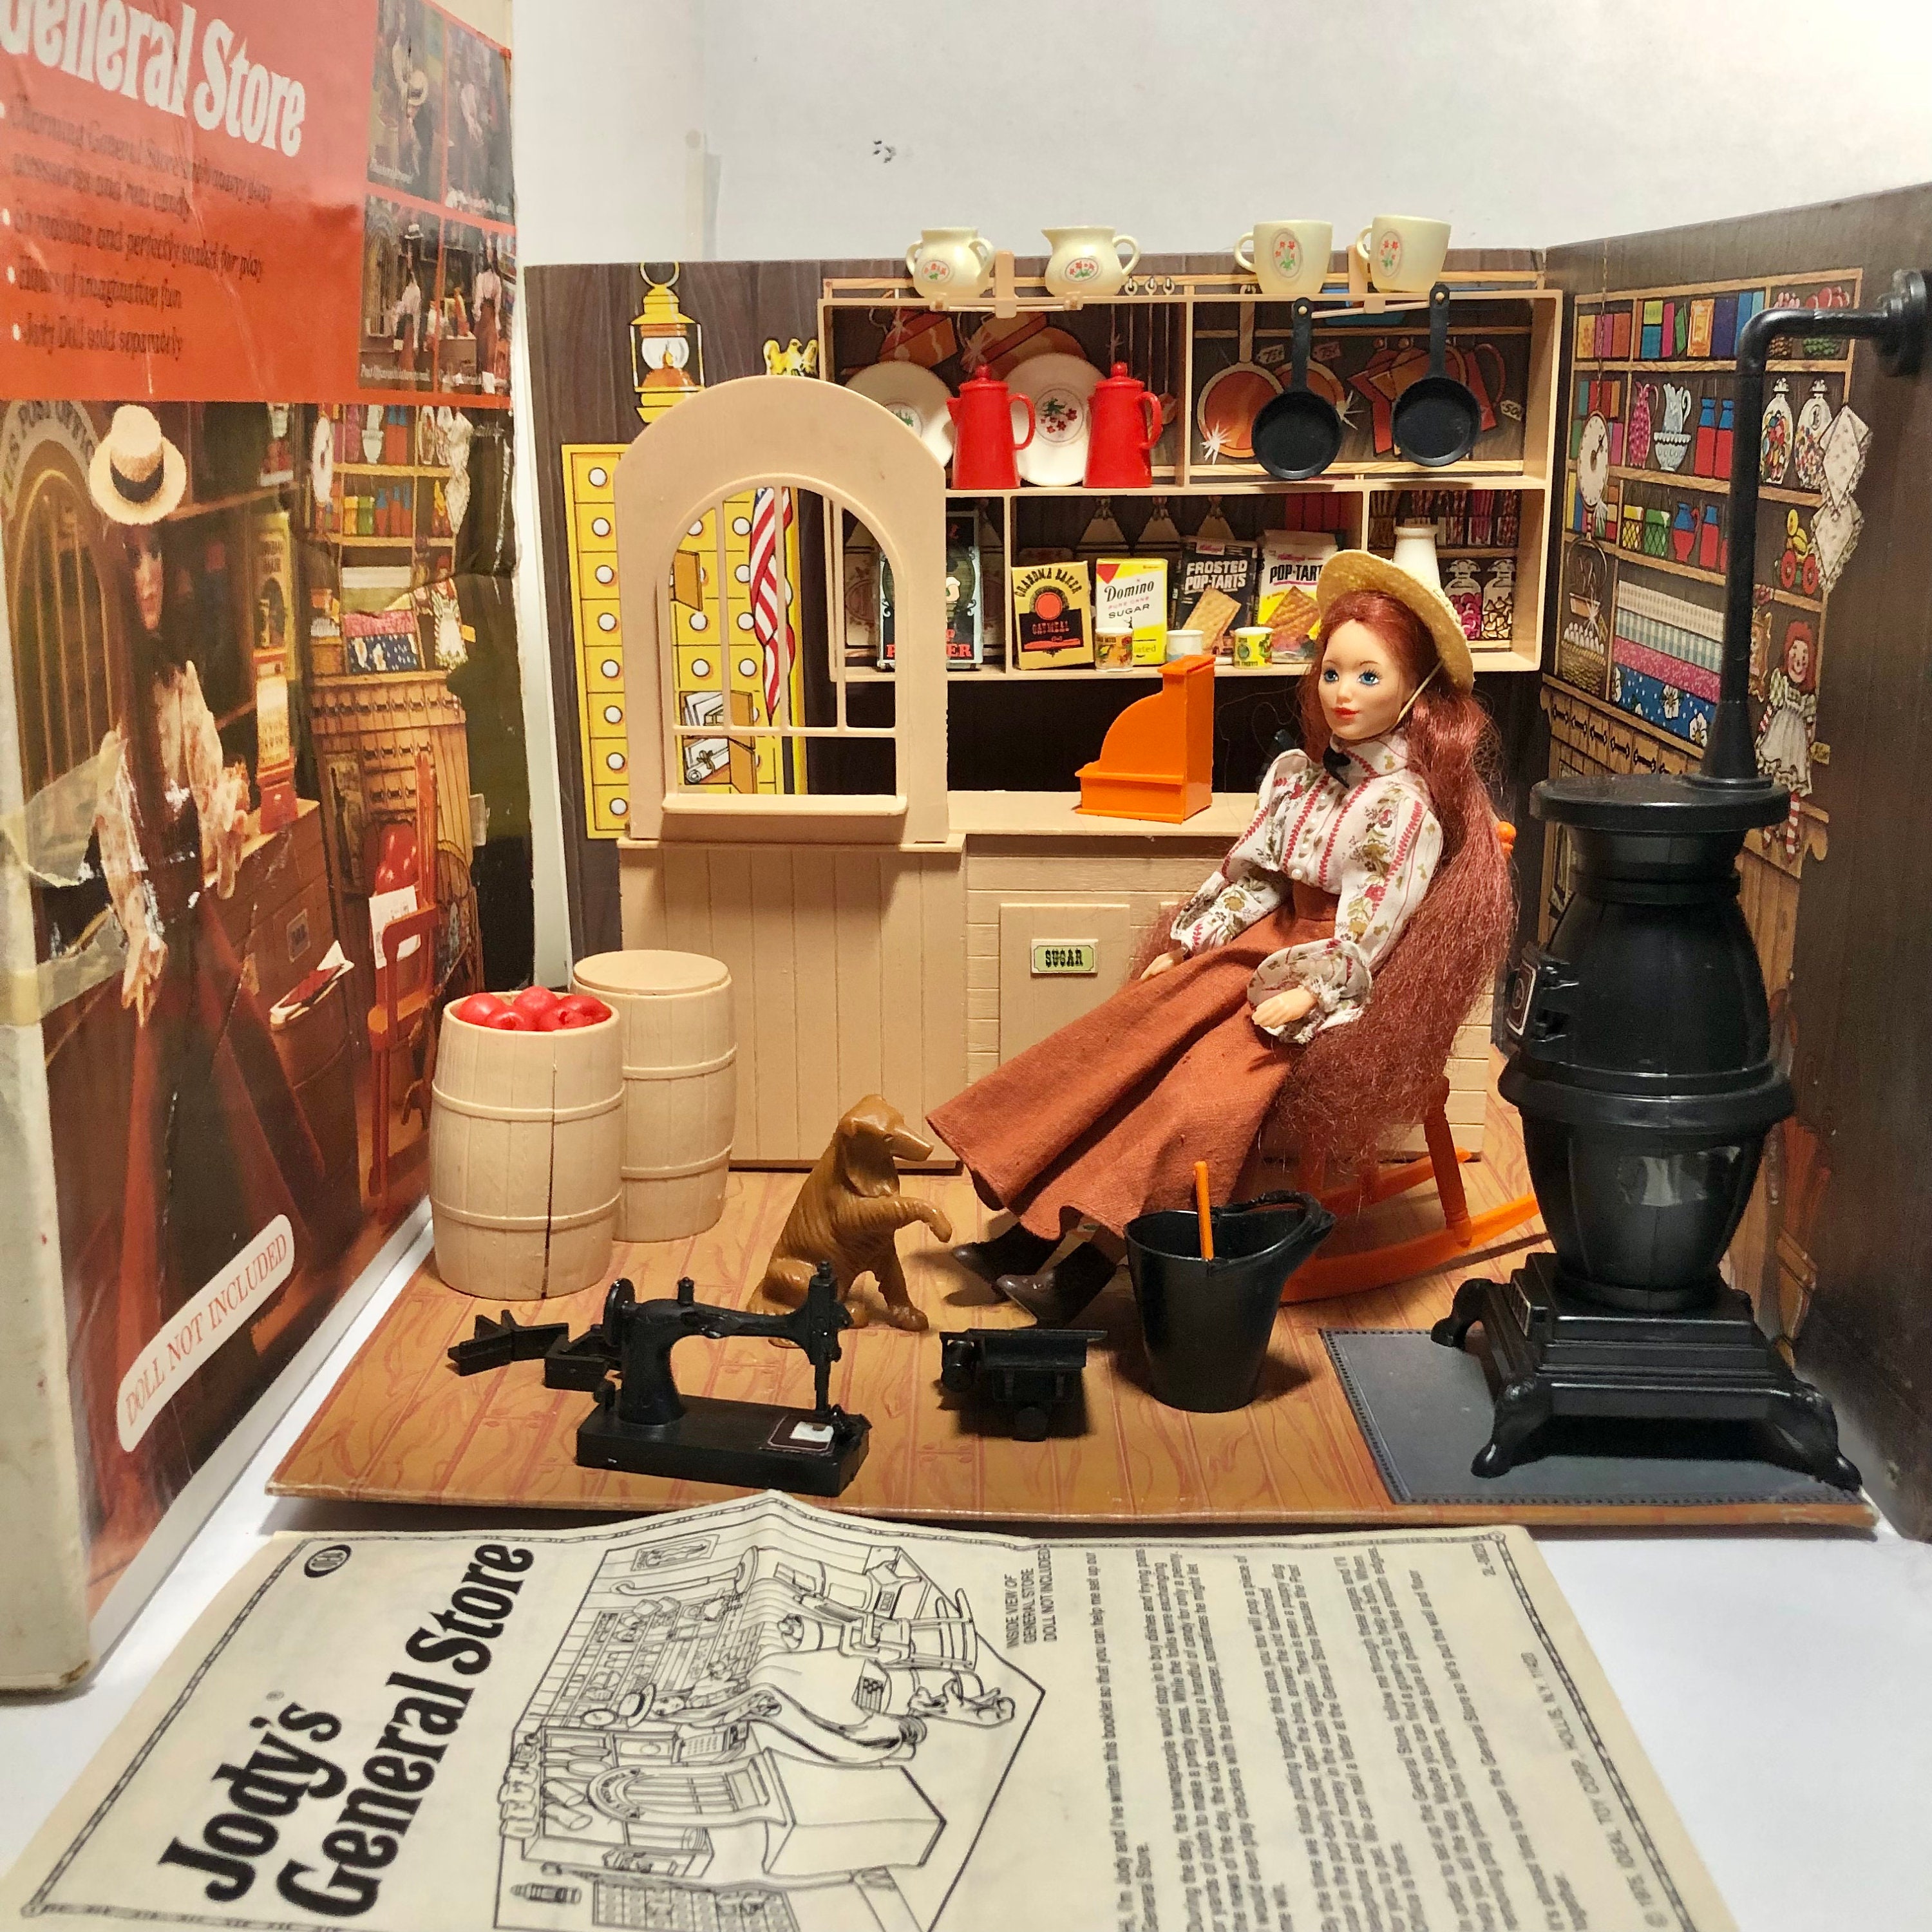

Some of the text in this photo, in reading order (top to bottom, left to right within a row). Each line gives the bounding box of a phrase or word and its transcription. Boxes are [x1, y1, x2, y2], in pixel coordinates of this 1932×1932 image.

[0, 0, 306, 157] eneral Store
[1014, 567, 1083, 598] GRANDMA BAKER
[1184, 573, 1247, 591] POP-TARTS
[1186, 560, 1248, 576] FROSTED
[1270, 564, 1324, 584] POP-TART
[1104, 580, 1155, 603] Domino
[1108, 603, 1151, 619] SUGAR
[1045, 948, 1084, 968] SUGAR
[125, 1233, 289, 1427] DOLL NOT INCLUDED
[1021, 1567, 1037, 1644] GENERAL STORE
[1037, 1548, 1057, 1642] DOLL NOT INCLUDED
[1005, 1573, 1019, 1649] INSIDE VIEW OF
[1095, 1647, 1110, 1663] you
[276, 1544, 535, 1917] General Store
[158, 1701, 348, 1903] Jody's
